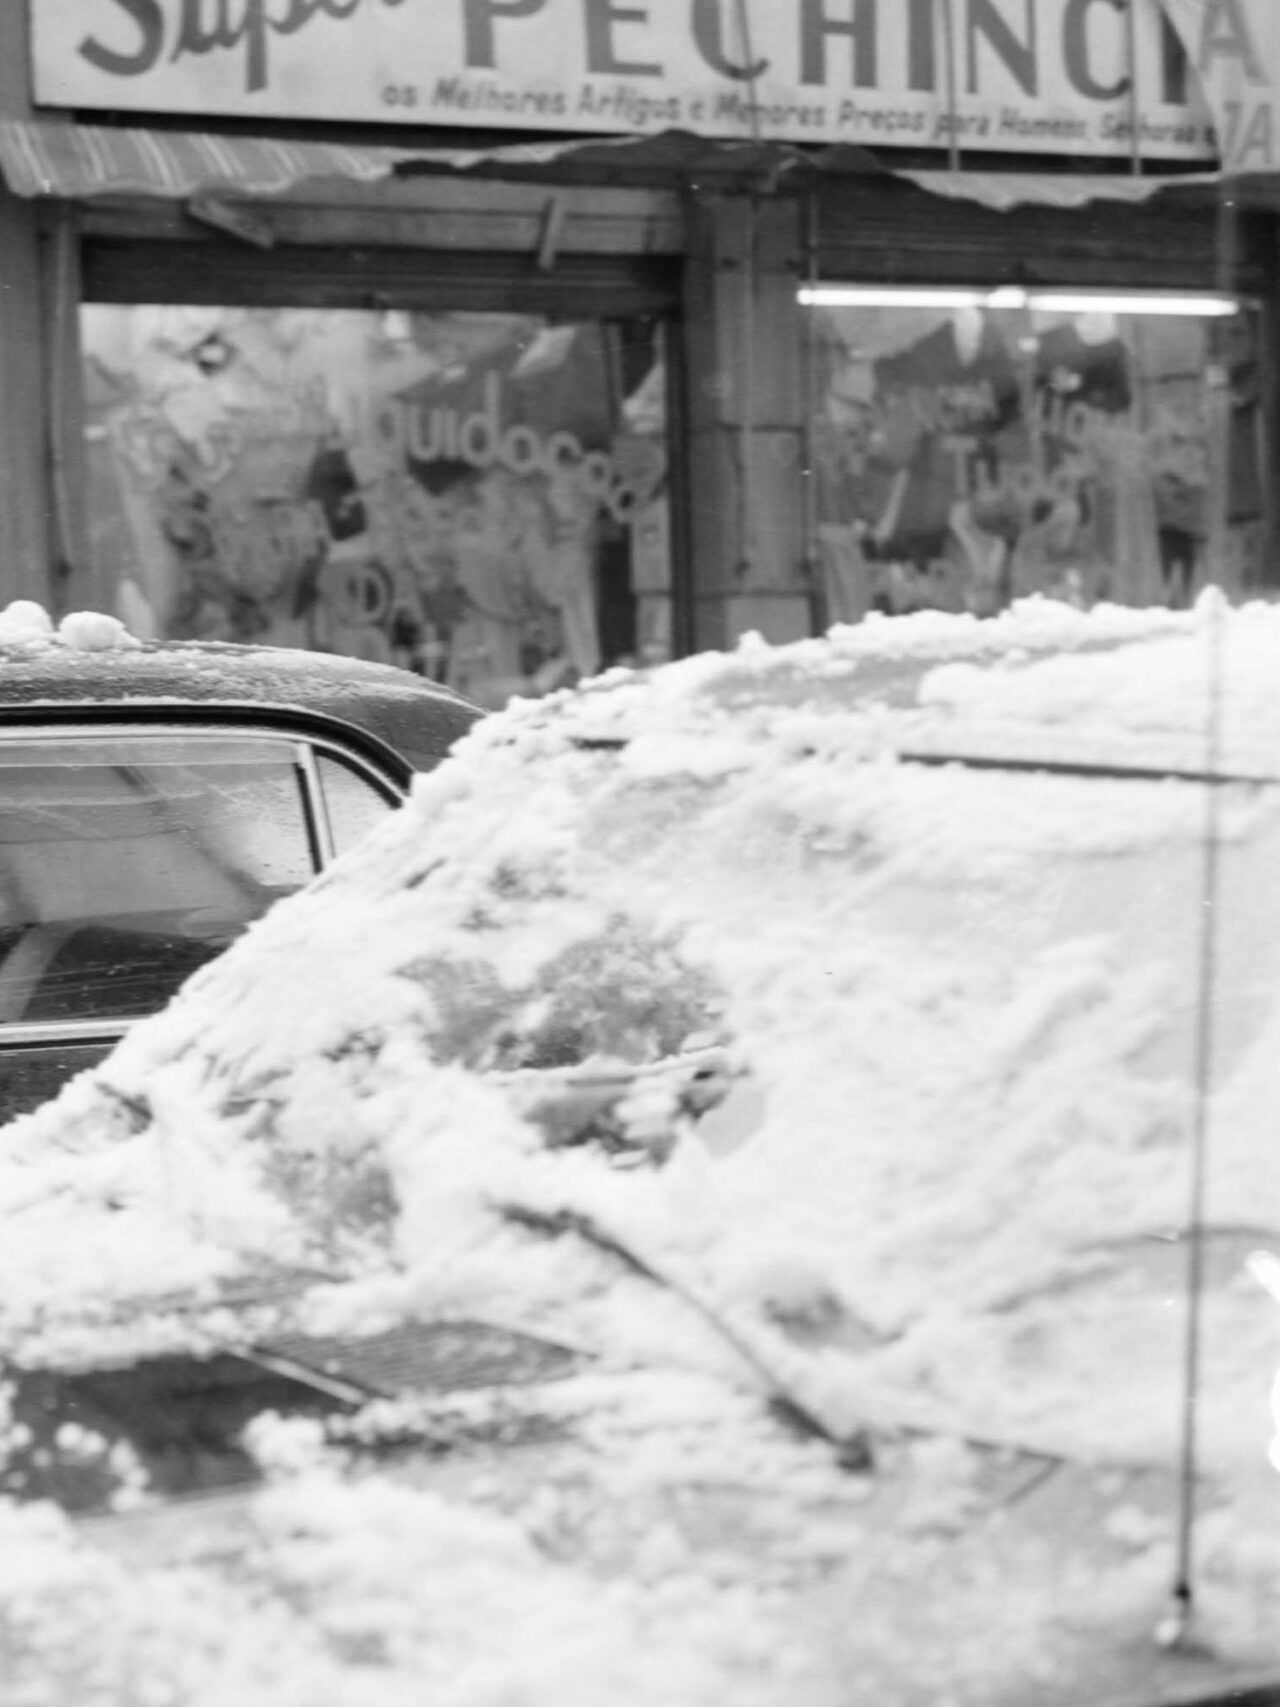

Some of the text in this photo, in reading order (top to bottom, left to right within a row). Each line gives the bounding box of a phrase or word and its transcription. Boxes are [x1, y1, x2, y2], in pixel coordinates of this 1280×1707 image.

[78, 0, 406, 92] Sup
[429, 77, 567, 115] Melhores
[577, 83, 680, 127] Artigos
[713, 92, 826, 127] Menores
